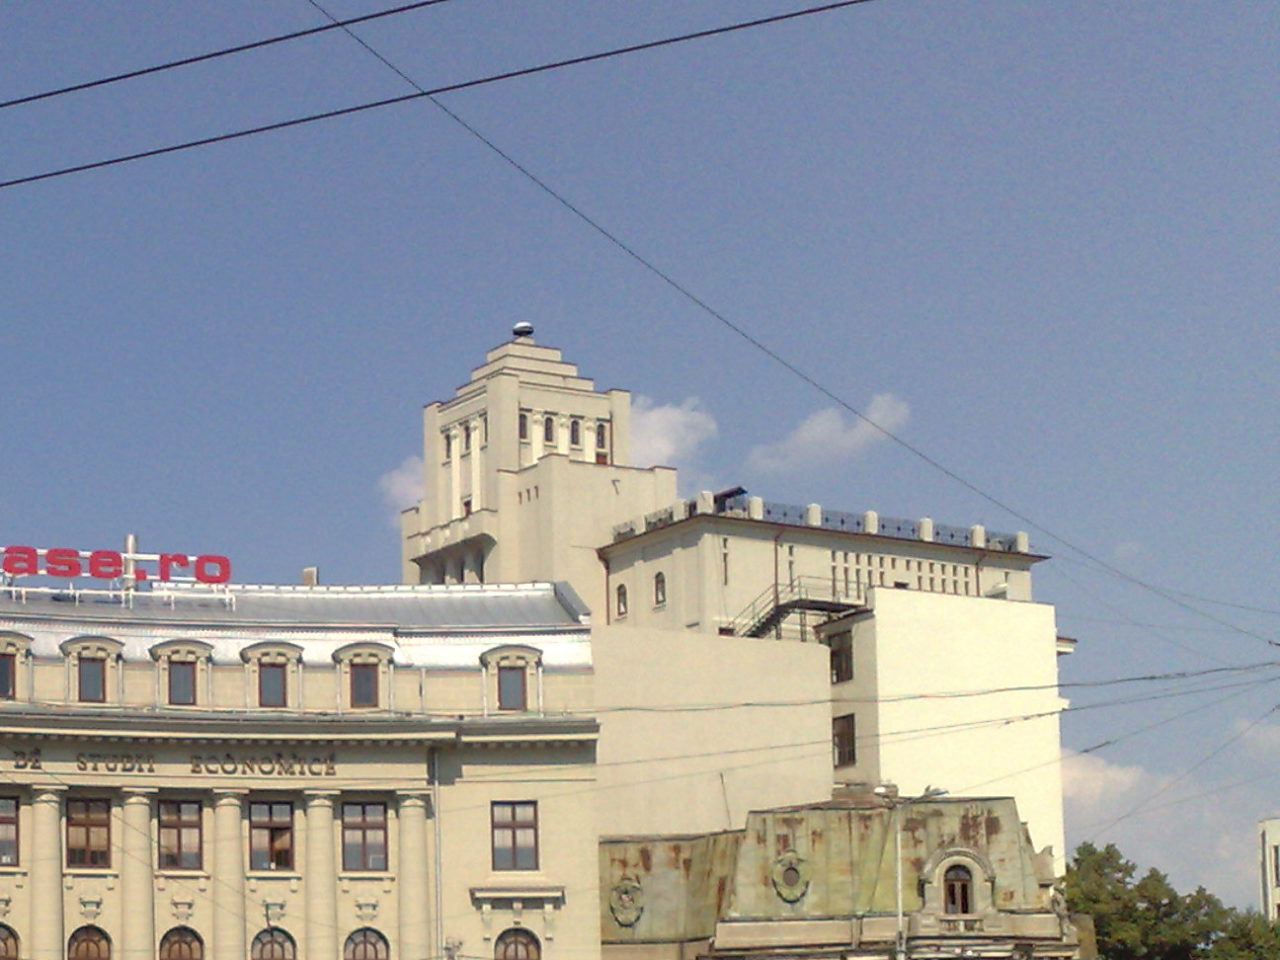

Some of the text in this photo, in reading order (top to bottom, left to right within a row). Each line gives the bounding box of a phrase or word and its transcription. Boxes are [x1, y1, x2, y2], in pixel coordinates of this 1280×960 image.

[14, 748, 42, 769] DE
[77, 754, 156, 774] STUDII
[192, 754, 336, 776] ECONOMICE
